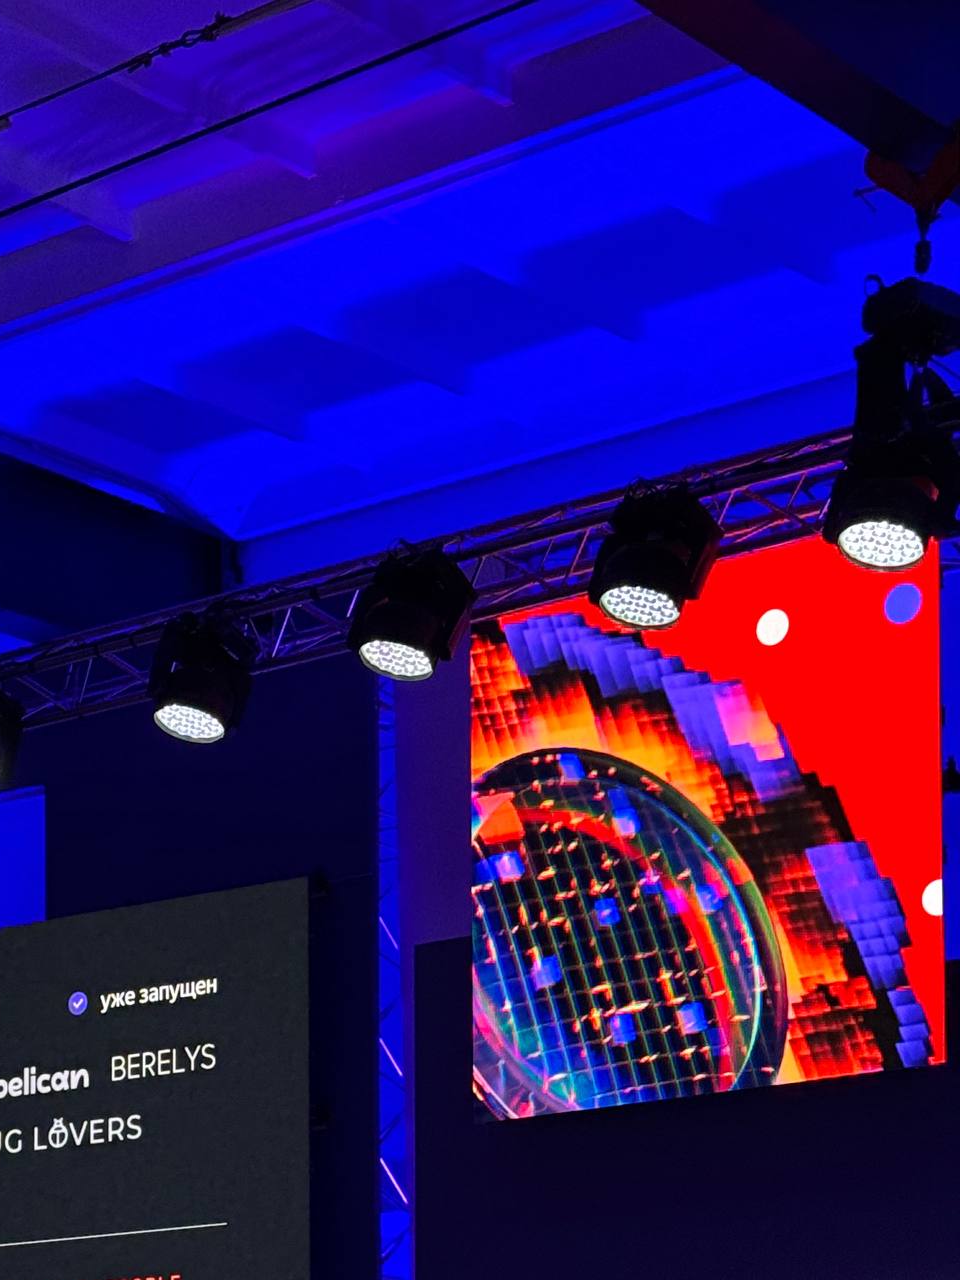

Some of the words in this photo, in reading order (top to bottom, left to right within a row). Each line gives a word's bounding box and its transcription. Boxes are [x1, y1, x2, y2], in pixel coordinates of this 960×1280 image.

[99, 990, 136, 1013] уже
[138, 977, 218, 1004] запущен
[111, 1043, 216, 1082] BERELYS
[33, 1114, 142, 1151] LOVERS
